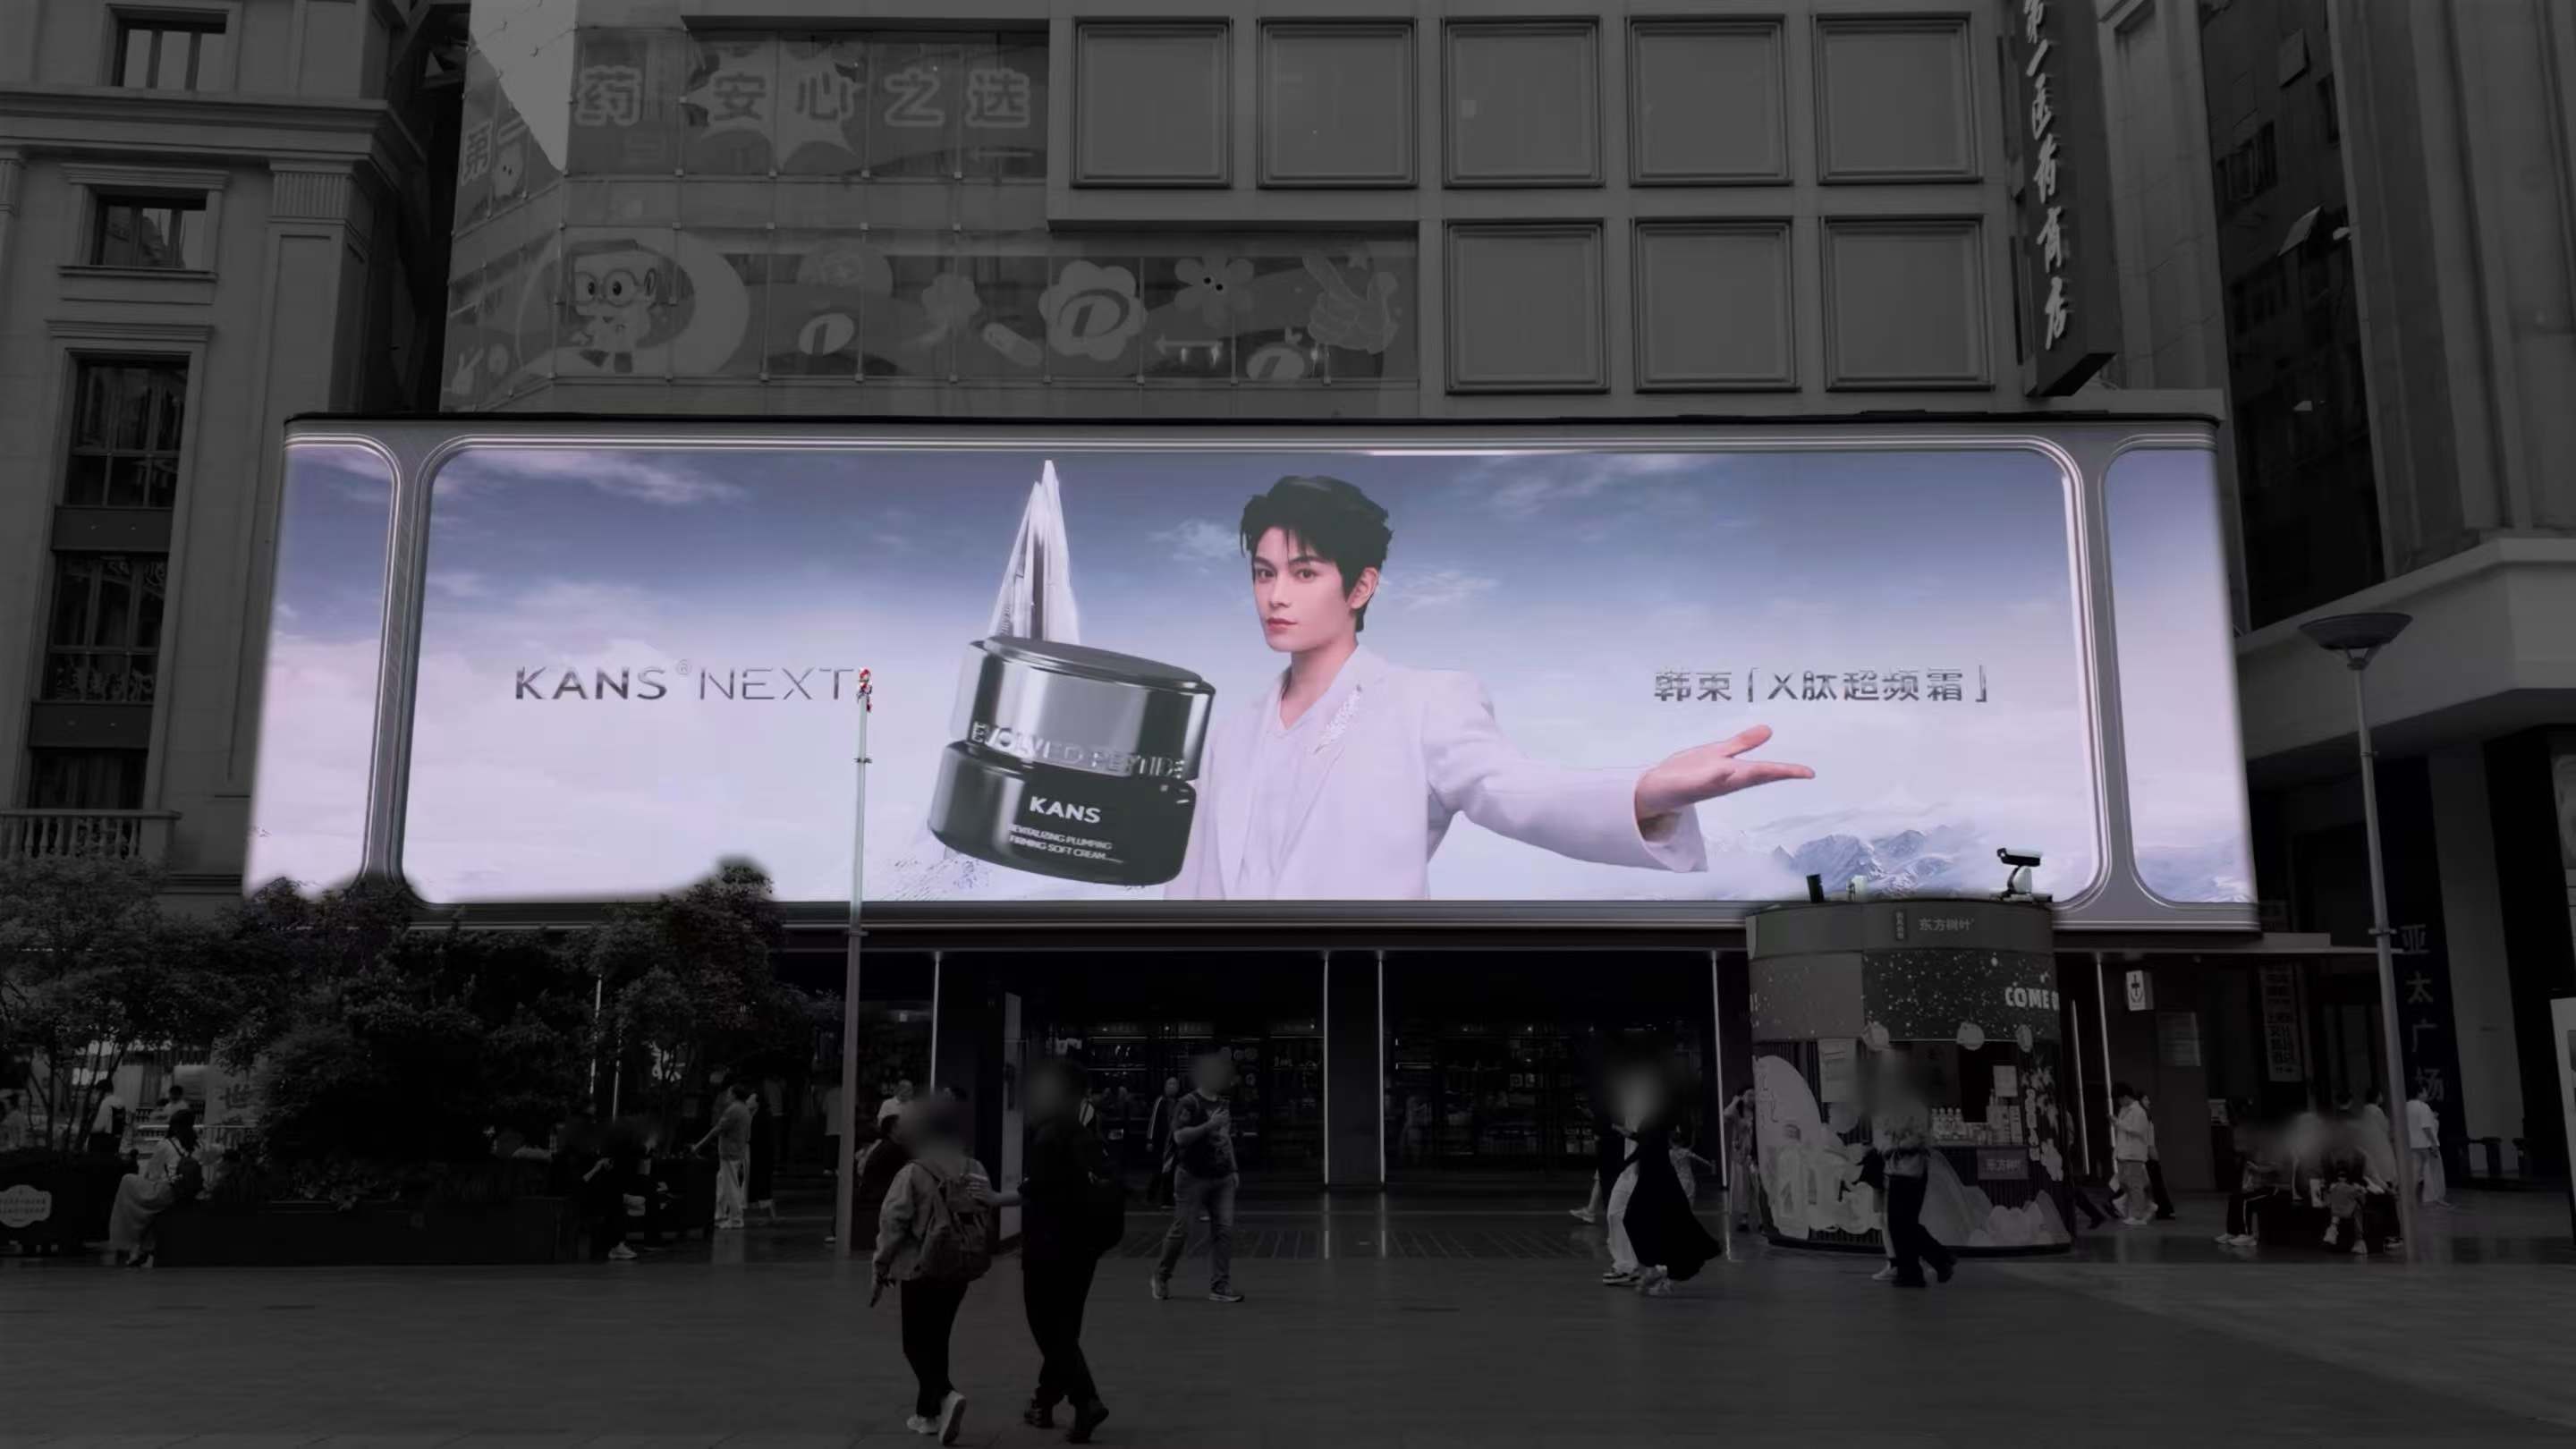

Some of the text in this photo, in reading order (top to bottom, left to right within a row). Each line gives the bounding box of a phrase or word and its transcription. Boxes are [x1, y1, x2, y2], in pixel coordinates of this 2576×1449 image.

[712, 67, 1030, 128] 安心之选
[699, 667, 854, 700] NEXT
[1030, 796, 1101, 824] KANS
[1009, 835, 1106, 860] FIRMING SOFT CREAM
[1065, 835, 1113, 850] PLUMPING
[2004, 987, 2049, 1009] COME
